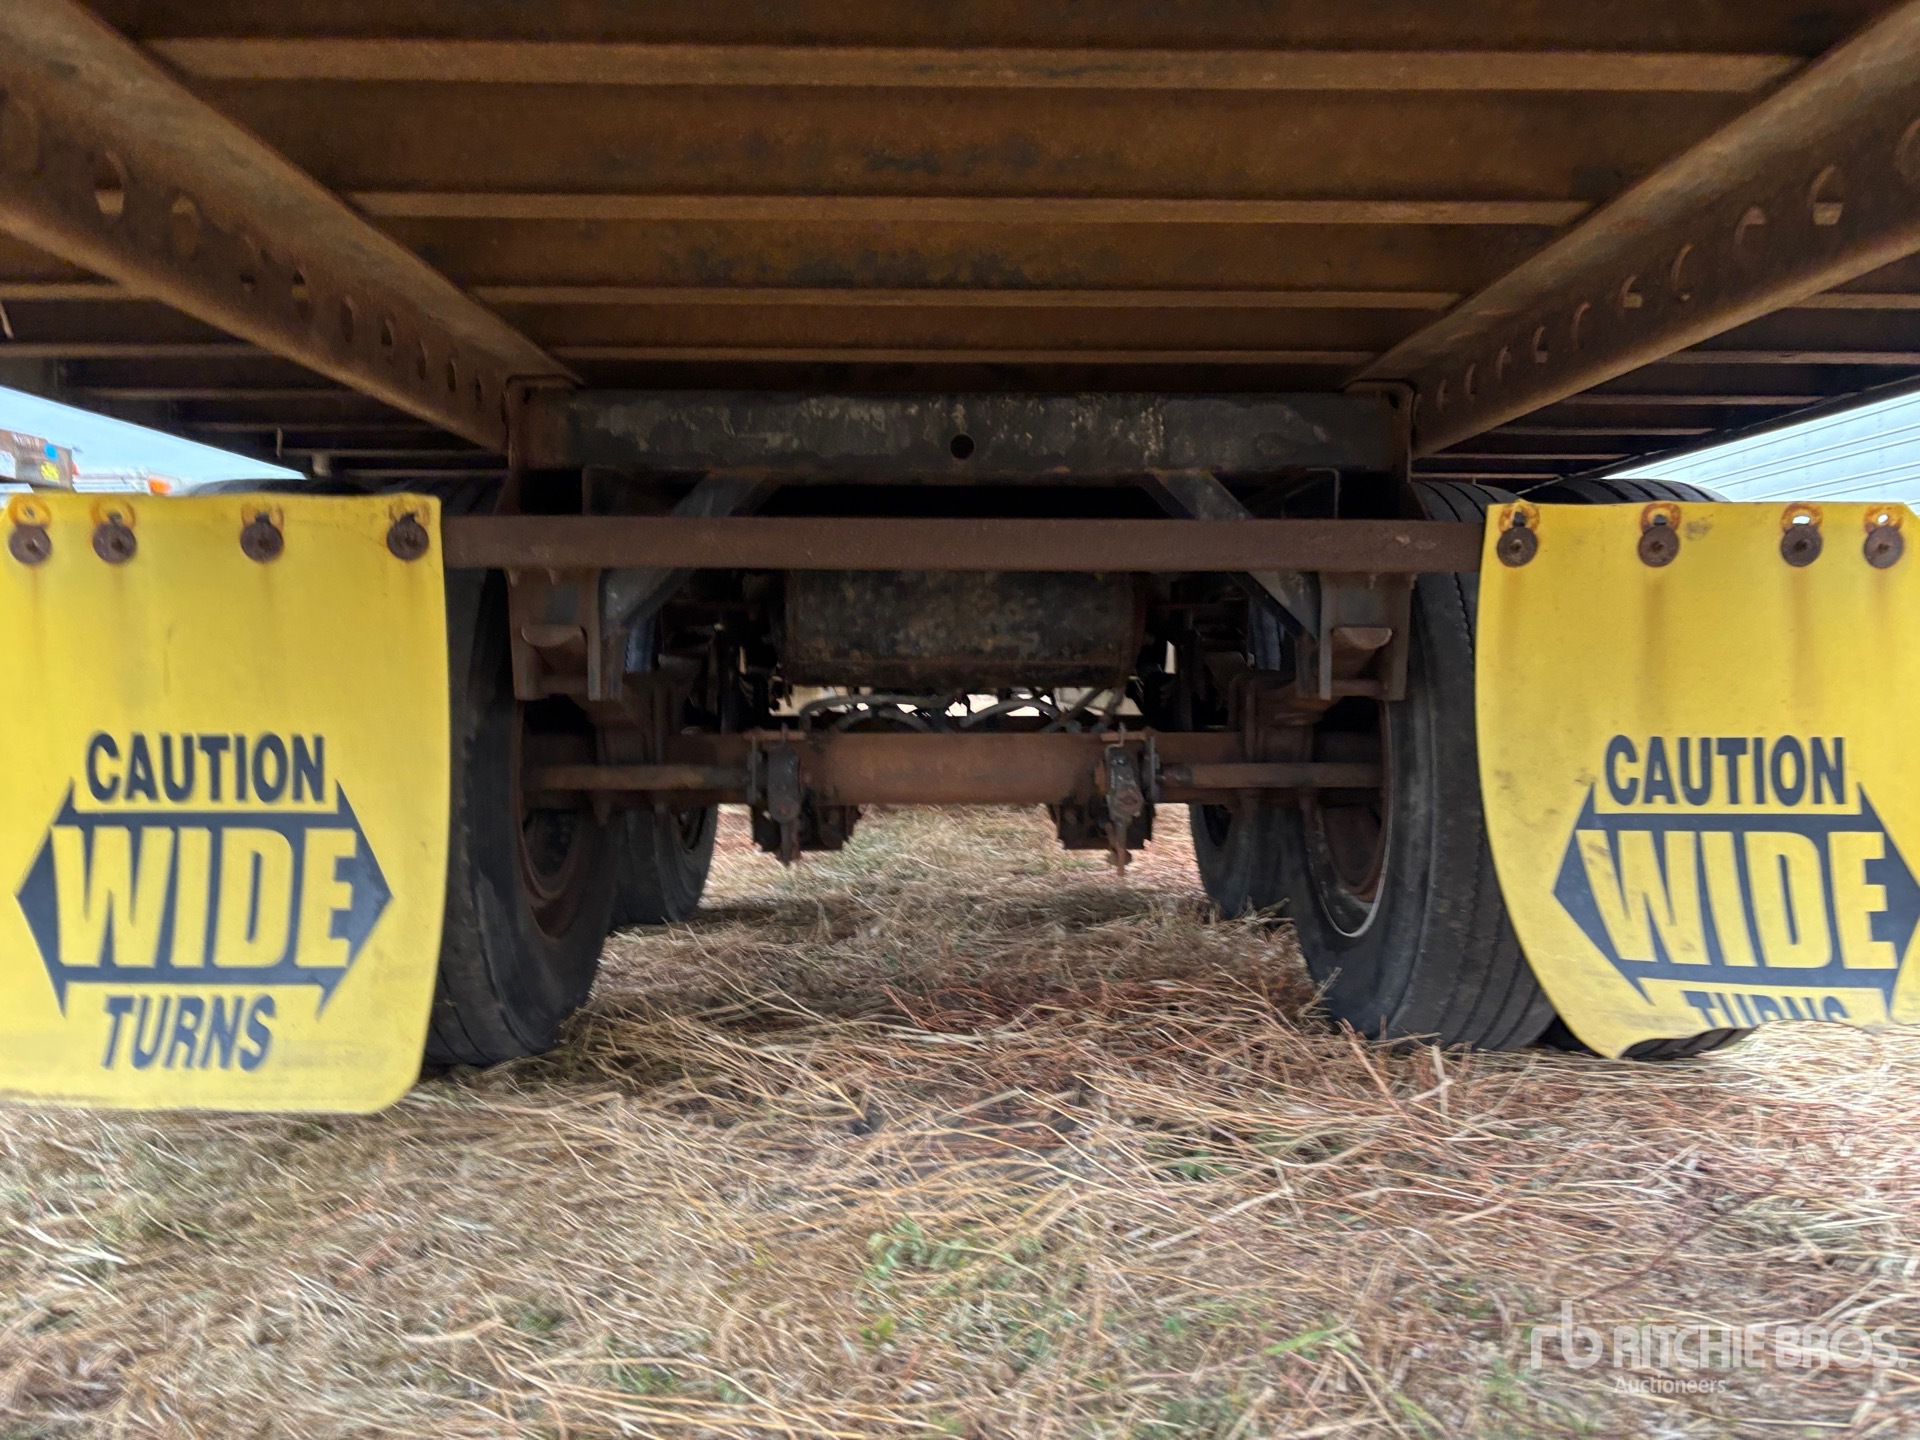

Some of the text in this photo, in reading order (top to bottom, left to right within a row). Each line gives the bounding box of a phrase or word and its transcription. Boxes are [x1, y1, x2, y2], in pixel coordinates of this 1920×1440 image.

[87, 731, 325, 803] CAUTION
[1604, 734, 1846, 807] CAUTION
[50, 826, 358, 969] WIDE
[1575, 830, 1899, 970] WIDE
[101, 994, 277, 1072] TURNS
